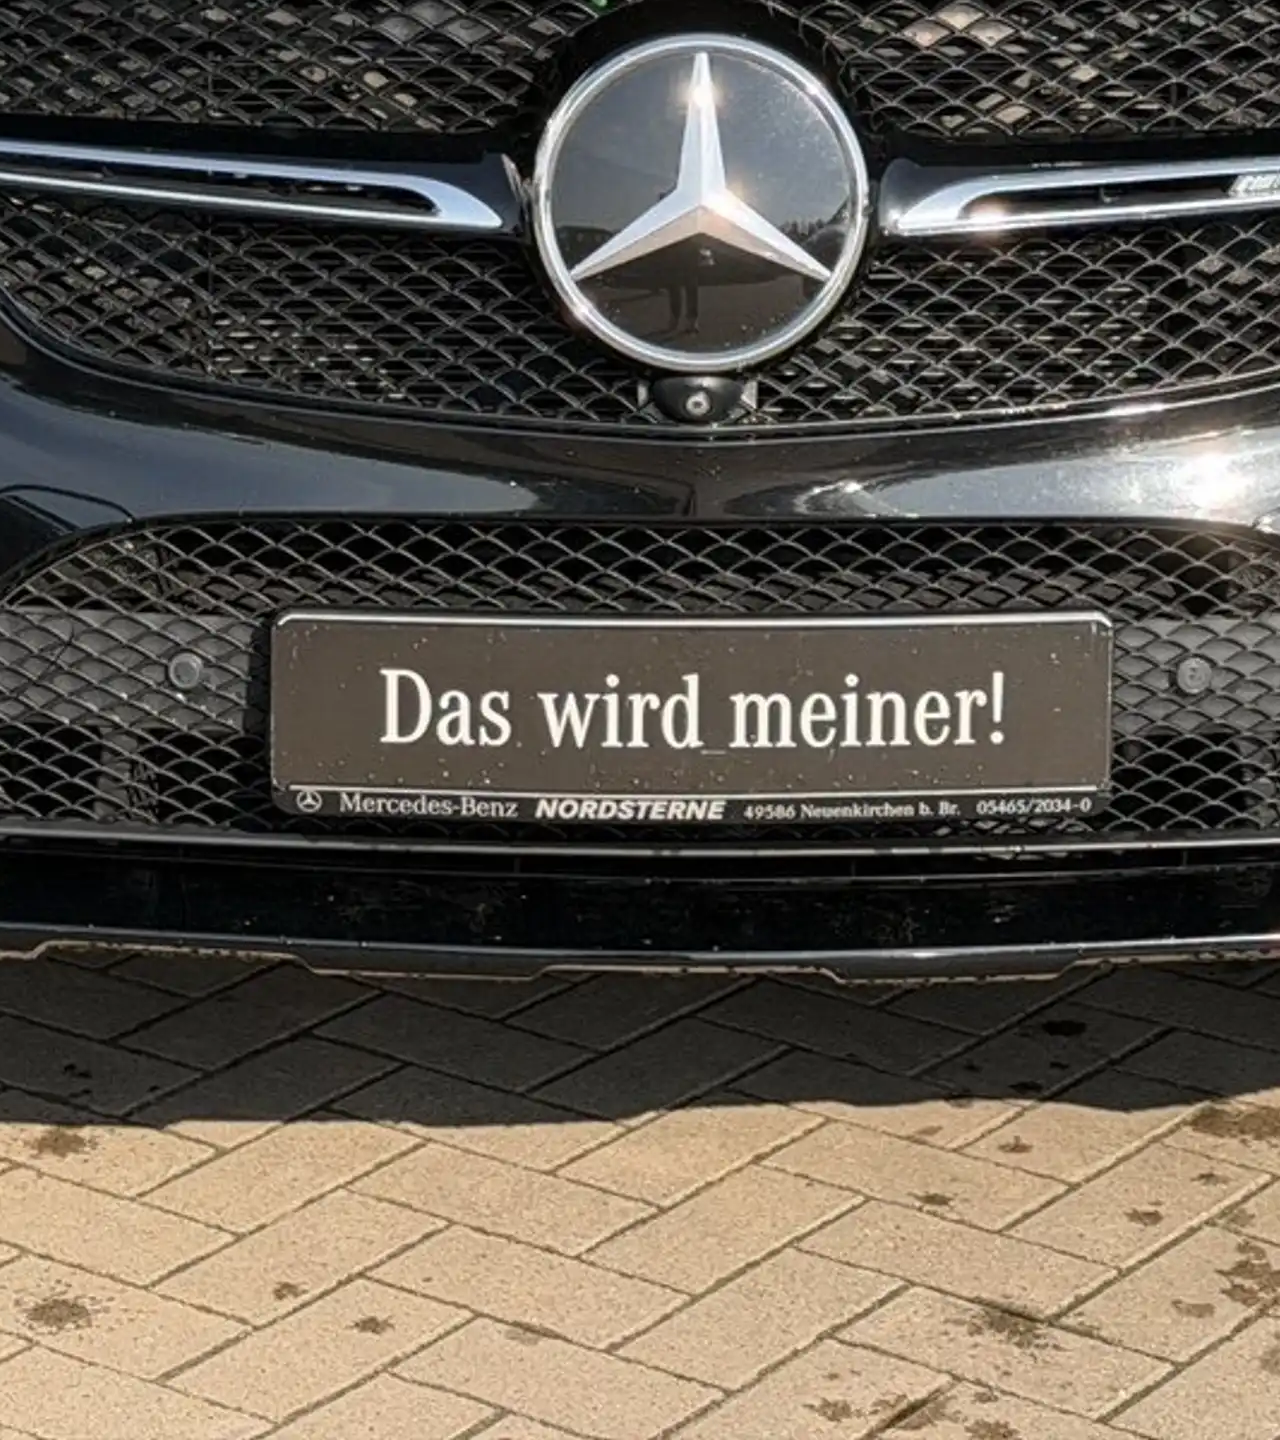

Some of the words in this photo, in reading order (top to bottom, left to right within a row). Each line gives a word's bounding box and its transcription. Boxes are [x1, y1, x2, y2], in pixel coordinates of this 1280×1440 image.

[380, 669, 512, 747] Das
[538, 673, 704, 748] wird
[729, 671, 1005, 748] meiner!
[339, 791, 519, 818] Mercedes-Benz
[535, 799, 726, 820] NORDSTERNE
[743, 805, 796, 820] 49586
[801, 803, 915, 819] Neuenkirchen
[919, 802, 934, 816] b.
[976, 797, 1092, 815] 05465/2034-0
